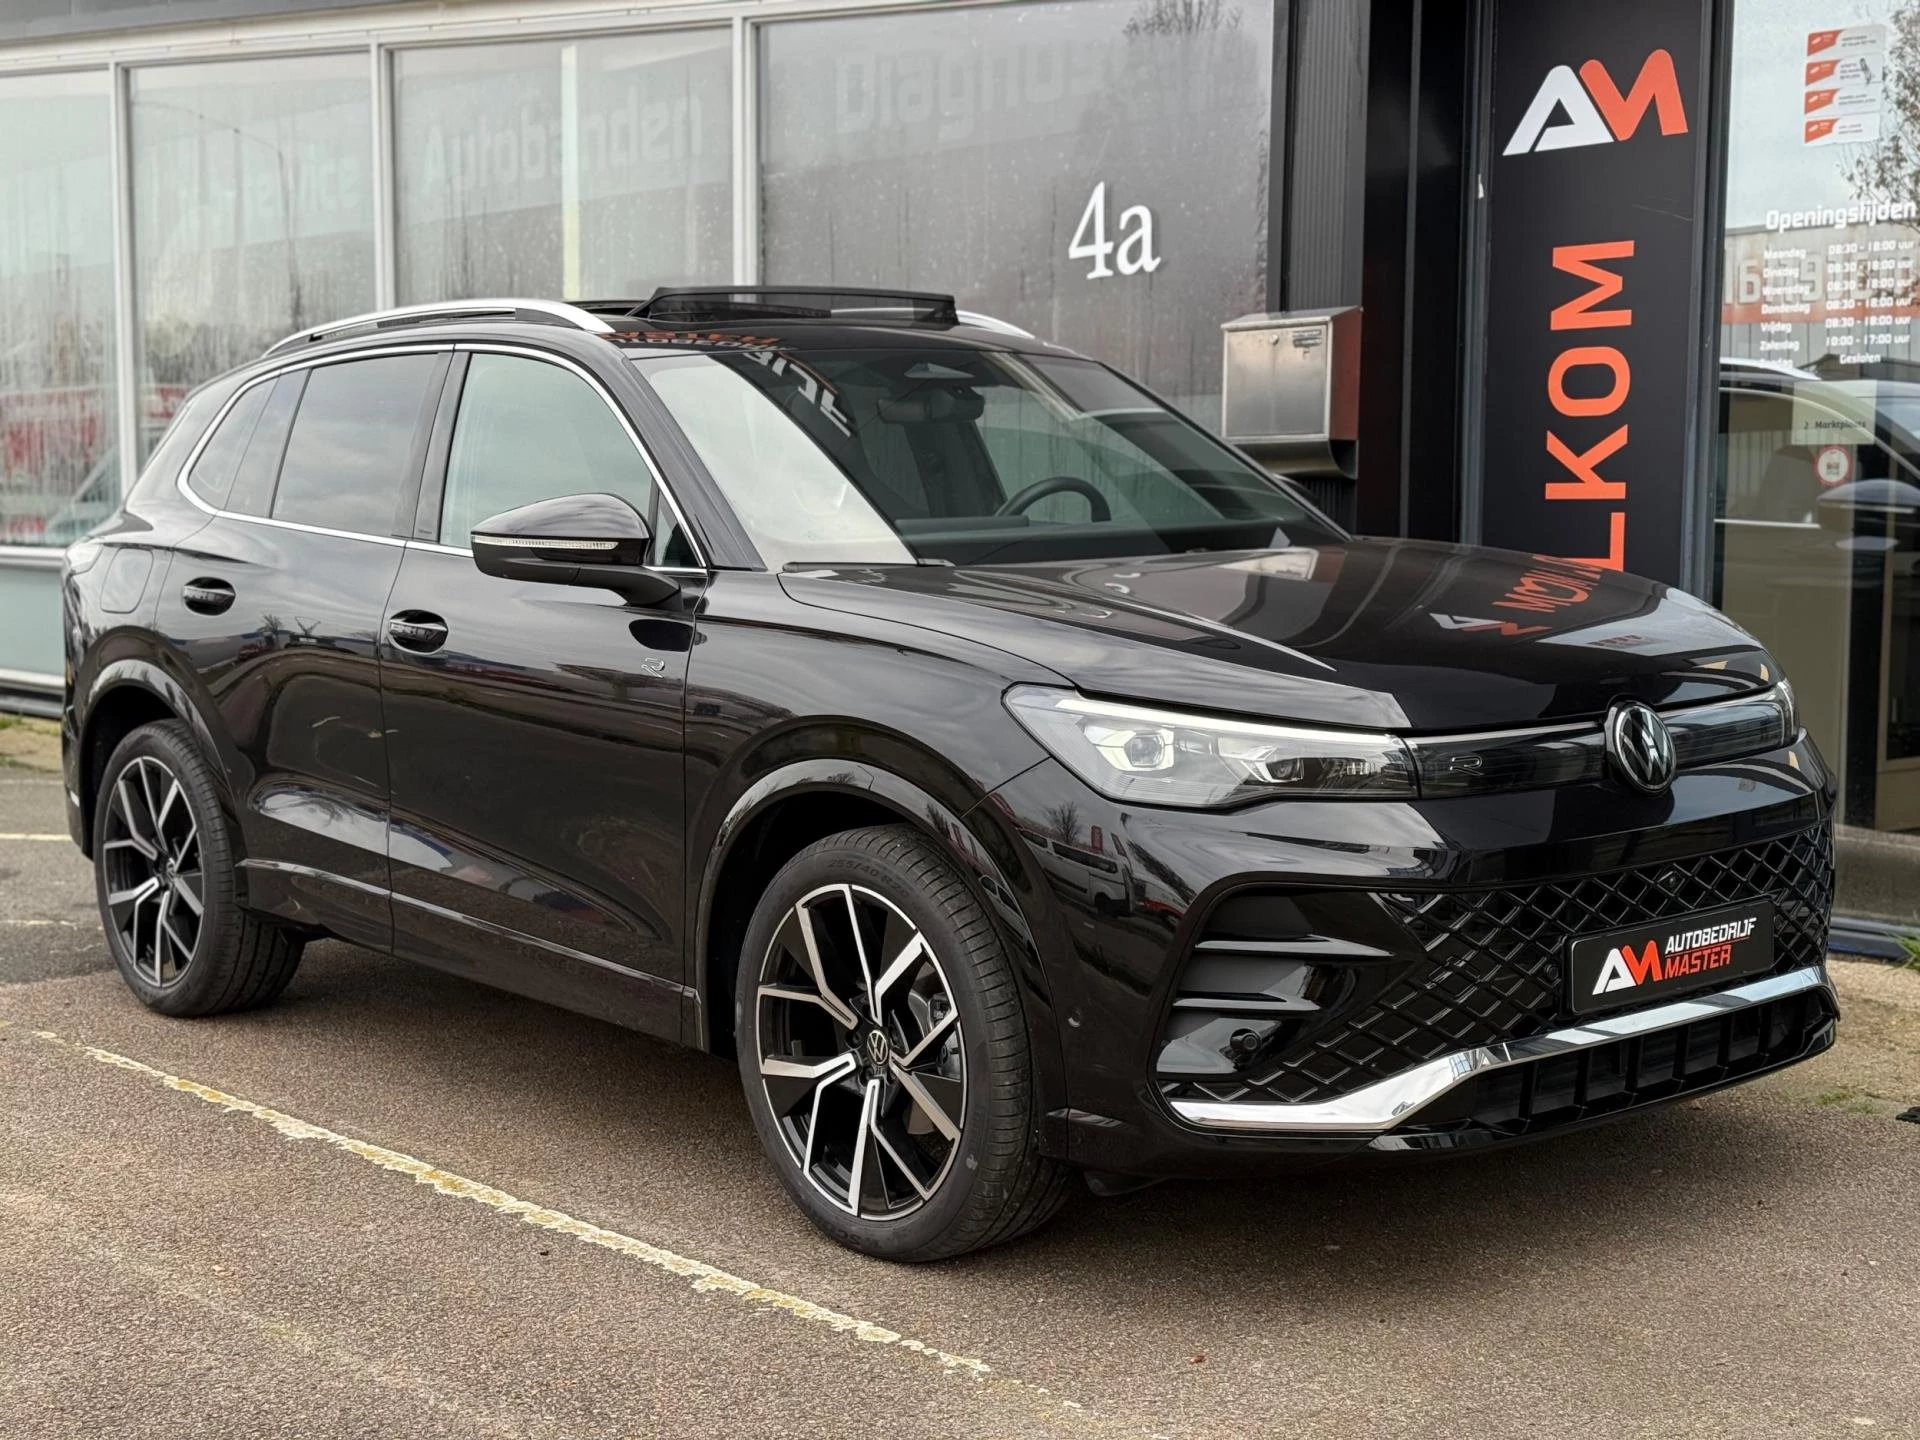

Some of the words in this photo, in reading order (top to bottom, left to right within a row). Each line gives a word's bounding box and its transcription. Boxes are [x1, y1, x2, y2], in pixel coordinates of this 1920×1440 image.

[1503, 49, 1688, 156] AM
[1068, 181, 1161, 280] 4a
[1766, 199, 1917, 233] Openingstijden
[1545, 240, 1635, 572] LKOM
[1592, 939, 1663, 995] AM
[1665, 917, 1757, 955] AUTOBEDRIJF
[1664, 944, 1732, 979] MASTER
